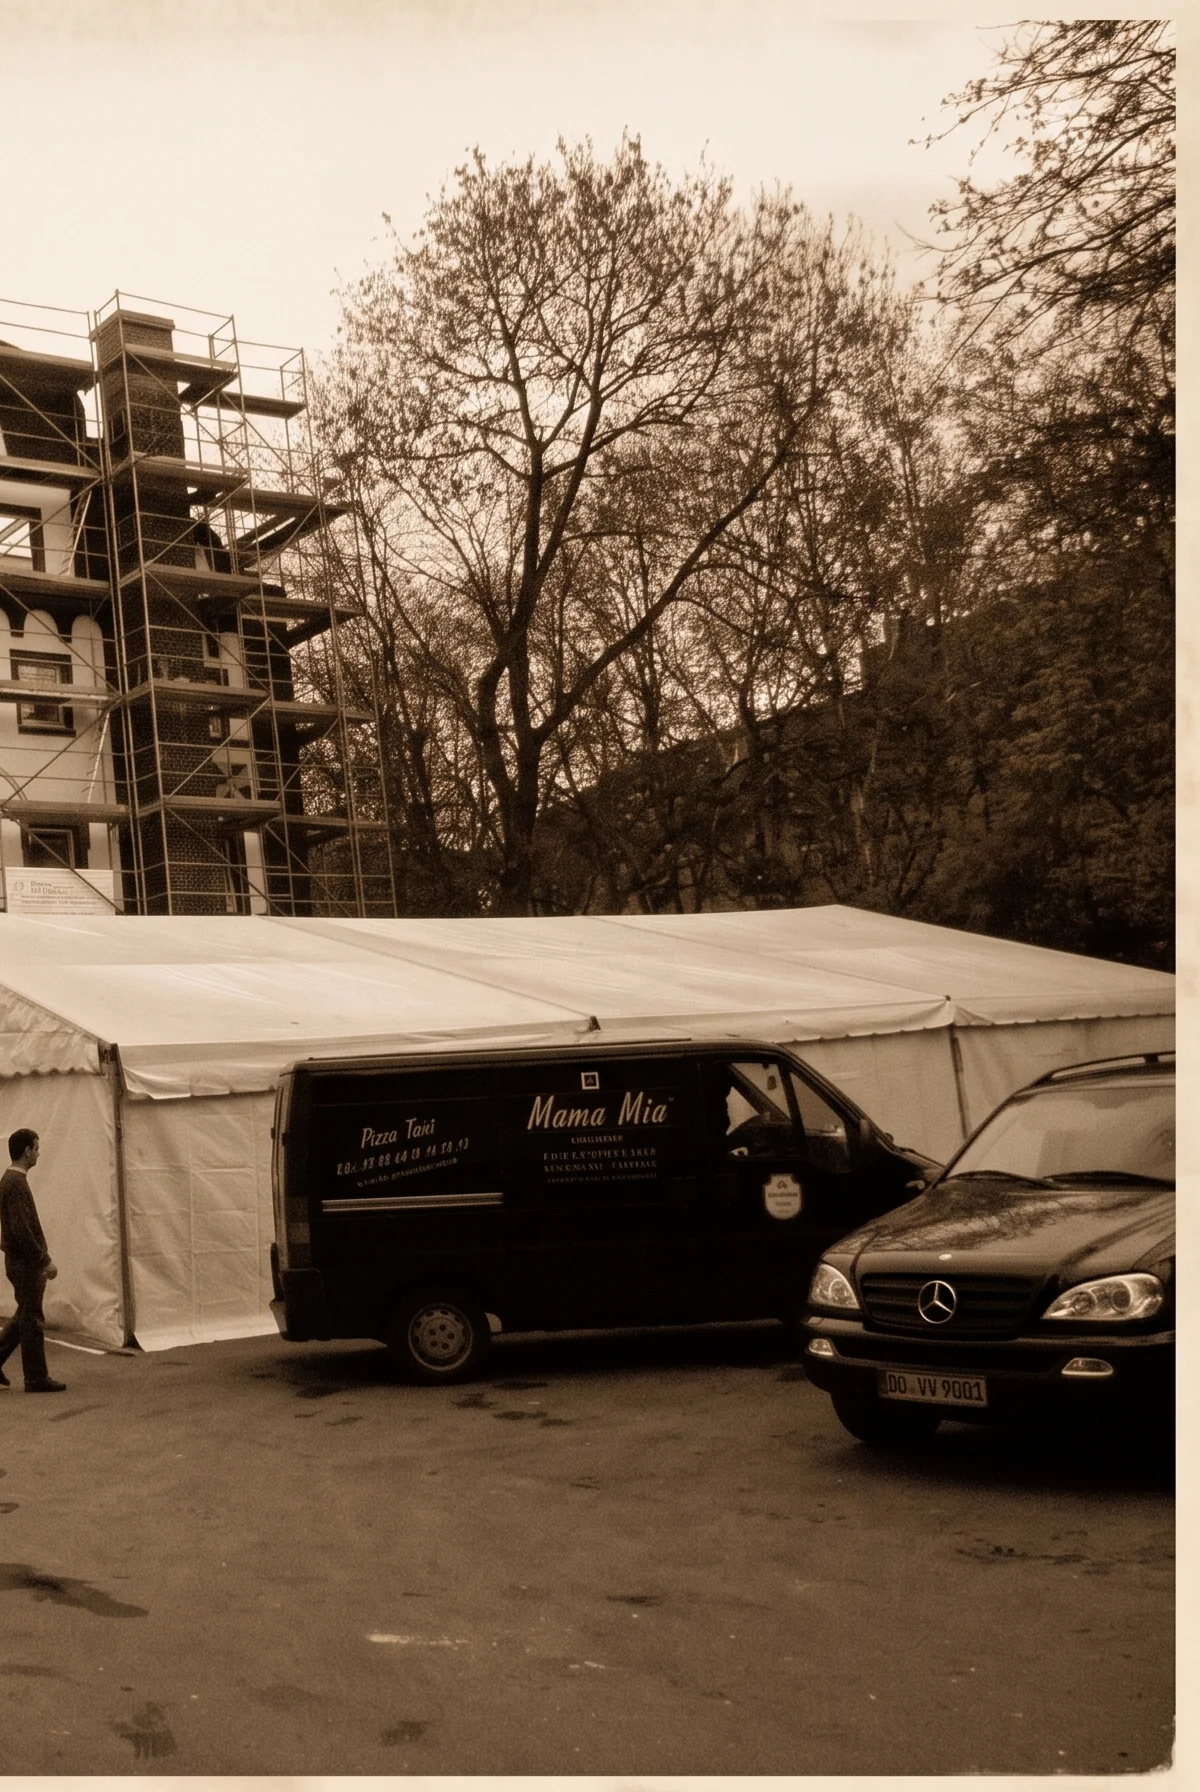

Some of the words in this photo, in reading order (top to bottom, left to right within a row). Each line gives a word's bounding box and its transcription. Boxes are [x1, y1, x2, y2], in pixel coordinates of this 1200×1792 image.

[526, 1095, 606, 1130] Mama
[617, 1091, 668, 1126] Mia
[360, 1127, 398, 1149] Pizza
[887, 1374, 907, 1395] DO
